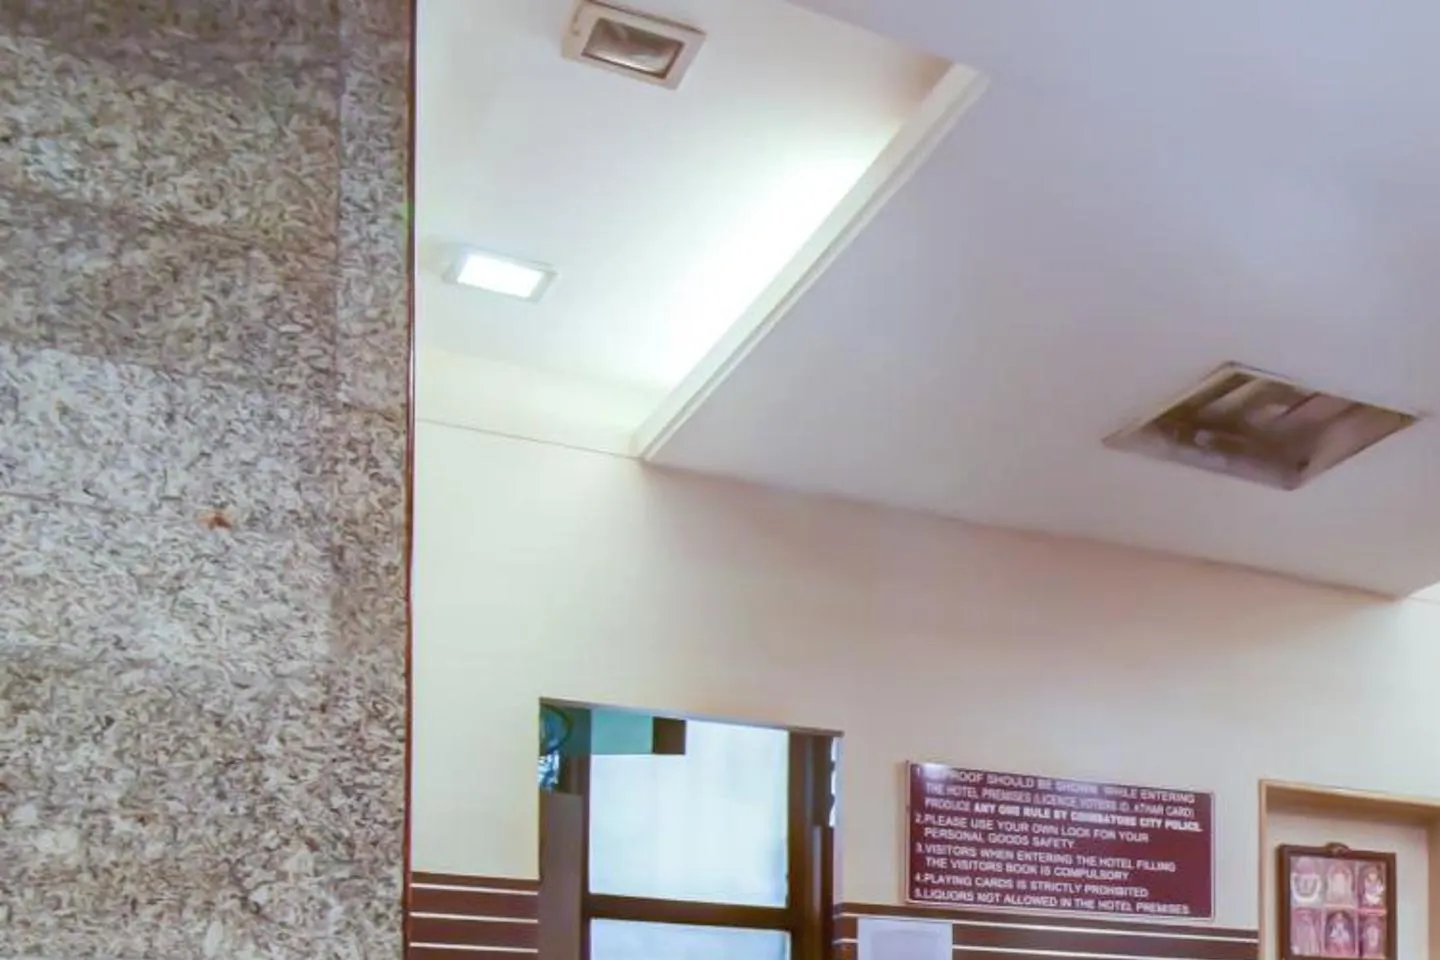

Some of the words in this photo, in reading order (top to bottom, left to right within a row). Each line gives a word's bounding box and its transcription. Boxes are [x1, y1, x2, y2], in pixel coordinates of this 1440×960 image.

[946, 785, 979, 799] HOTEL
[986, 773, 1034, 788] SHOULD
[1140, 789, 1195, 804] ENTERING
[973, 802, 996, 814] ANY
[1023, 806, 1050, 819] RULE
[1053, 810, 1068, 820] BY
[1139, 817, 1162, 828] CITY
[924, 827, 985, 843] PERSONAL
[988, 833, 1029, 846] GOODS
[1032, 836, 1075, 848] SAFETY
[970, 818, 993, 830] USE
[996, 820, 1029, 832] YOUR
[1032, 824, 1058, 835] OWN
[1061, 825, 1091, 838] LOCK
[1093, 828, 1116, 840] FOR
[1118, 831, 1149, 843] YOUR
[926, 857, 948, 869] THE
[950, 859, 1003, 872] VISITORS
[1005, 862, 1038, 875] BOOK
[1040, 865, 1051, 876] IS
[1053, 866, 1130, 880] COMPULSORY
[1016, 850, 1073, 865] ENTERING
[1076, 854, 1097, 866] THE
[1100, 857, 1134, 869] HOTEL
[1136, 859, 1176, 873] FILLING
[975, 876, 1014, 889] CARDS
[1016, 879, 1027, 890] IS
[1029, 880, 1082, 893] STRICTLY
[1084, 884, 1149, 898] PROHIBITED
[977, 891, 1001, 903] NOT
[1003, 893, 1057, 907] ALLOWED
[1059, 898, 1072, 907] IN
[1074, 898, 1095, 909] THE
[1098, 899, 1132, 912] HOTEL
